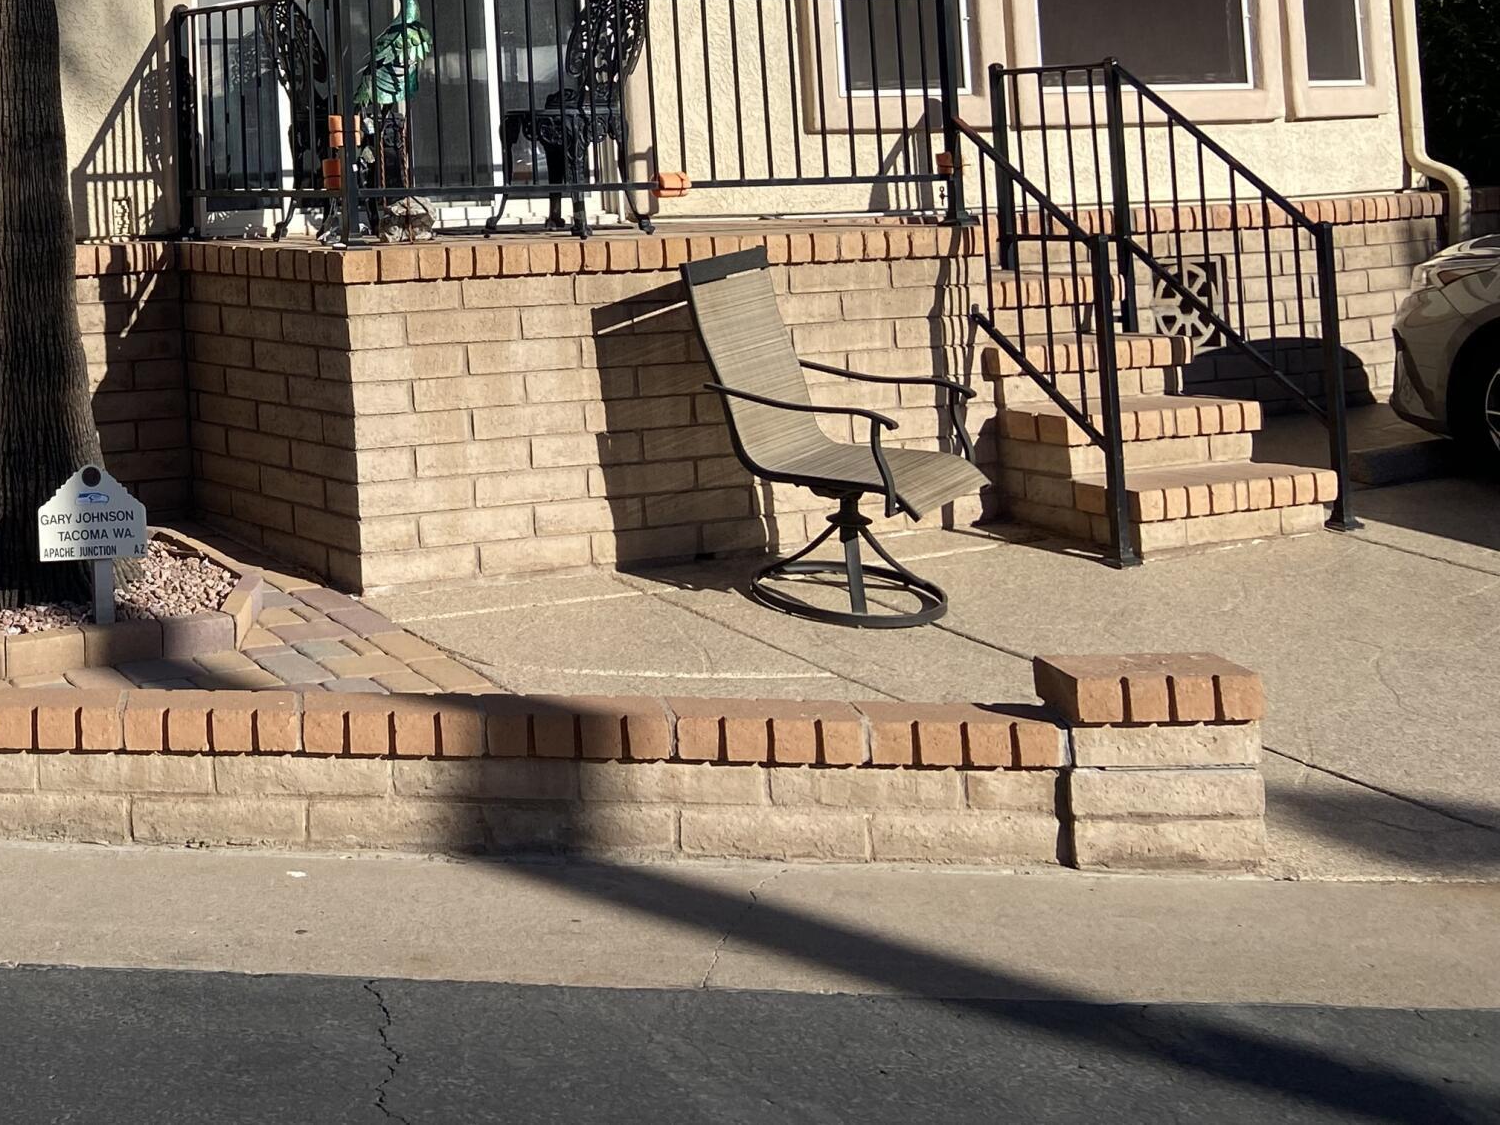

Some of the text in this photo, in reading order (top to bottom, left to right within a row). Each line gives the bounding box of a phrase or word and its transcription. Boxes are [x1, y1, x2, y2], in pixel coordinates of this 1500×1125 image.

[40, 510, 134, 525] GARY JOHNSON
[58, 527, 135, 541] TACOMA WA.
[44, 544, 145, 558] APACHE JUNCTION AZ
